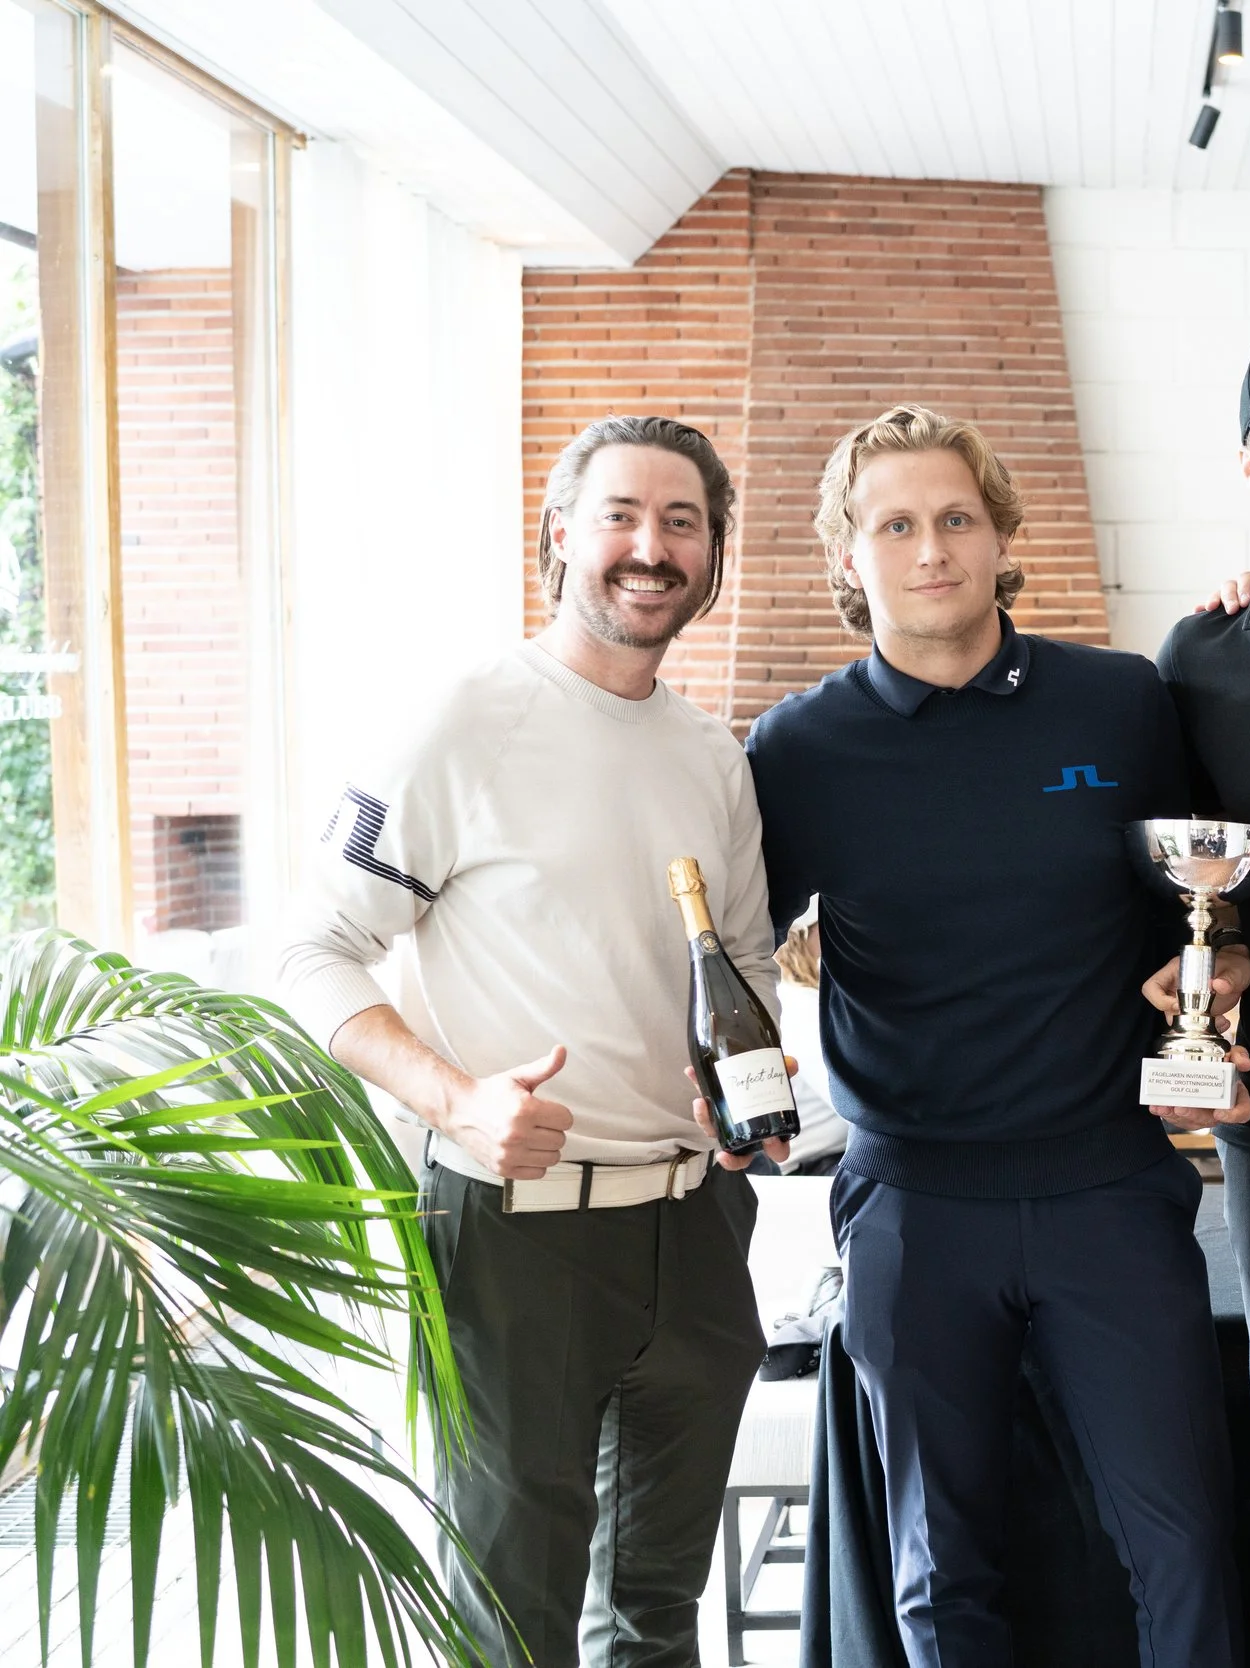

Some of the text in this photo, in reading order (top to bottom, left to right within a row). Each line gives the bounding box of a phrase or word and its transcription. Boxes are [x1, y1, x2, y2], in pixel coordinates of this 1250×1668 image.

[727, 1066, 786, 1091] Perfect day
[1186, 1073, 1219, 1081] INVITATIONAL
